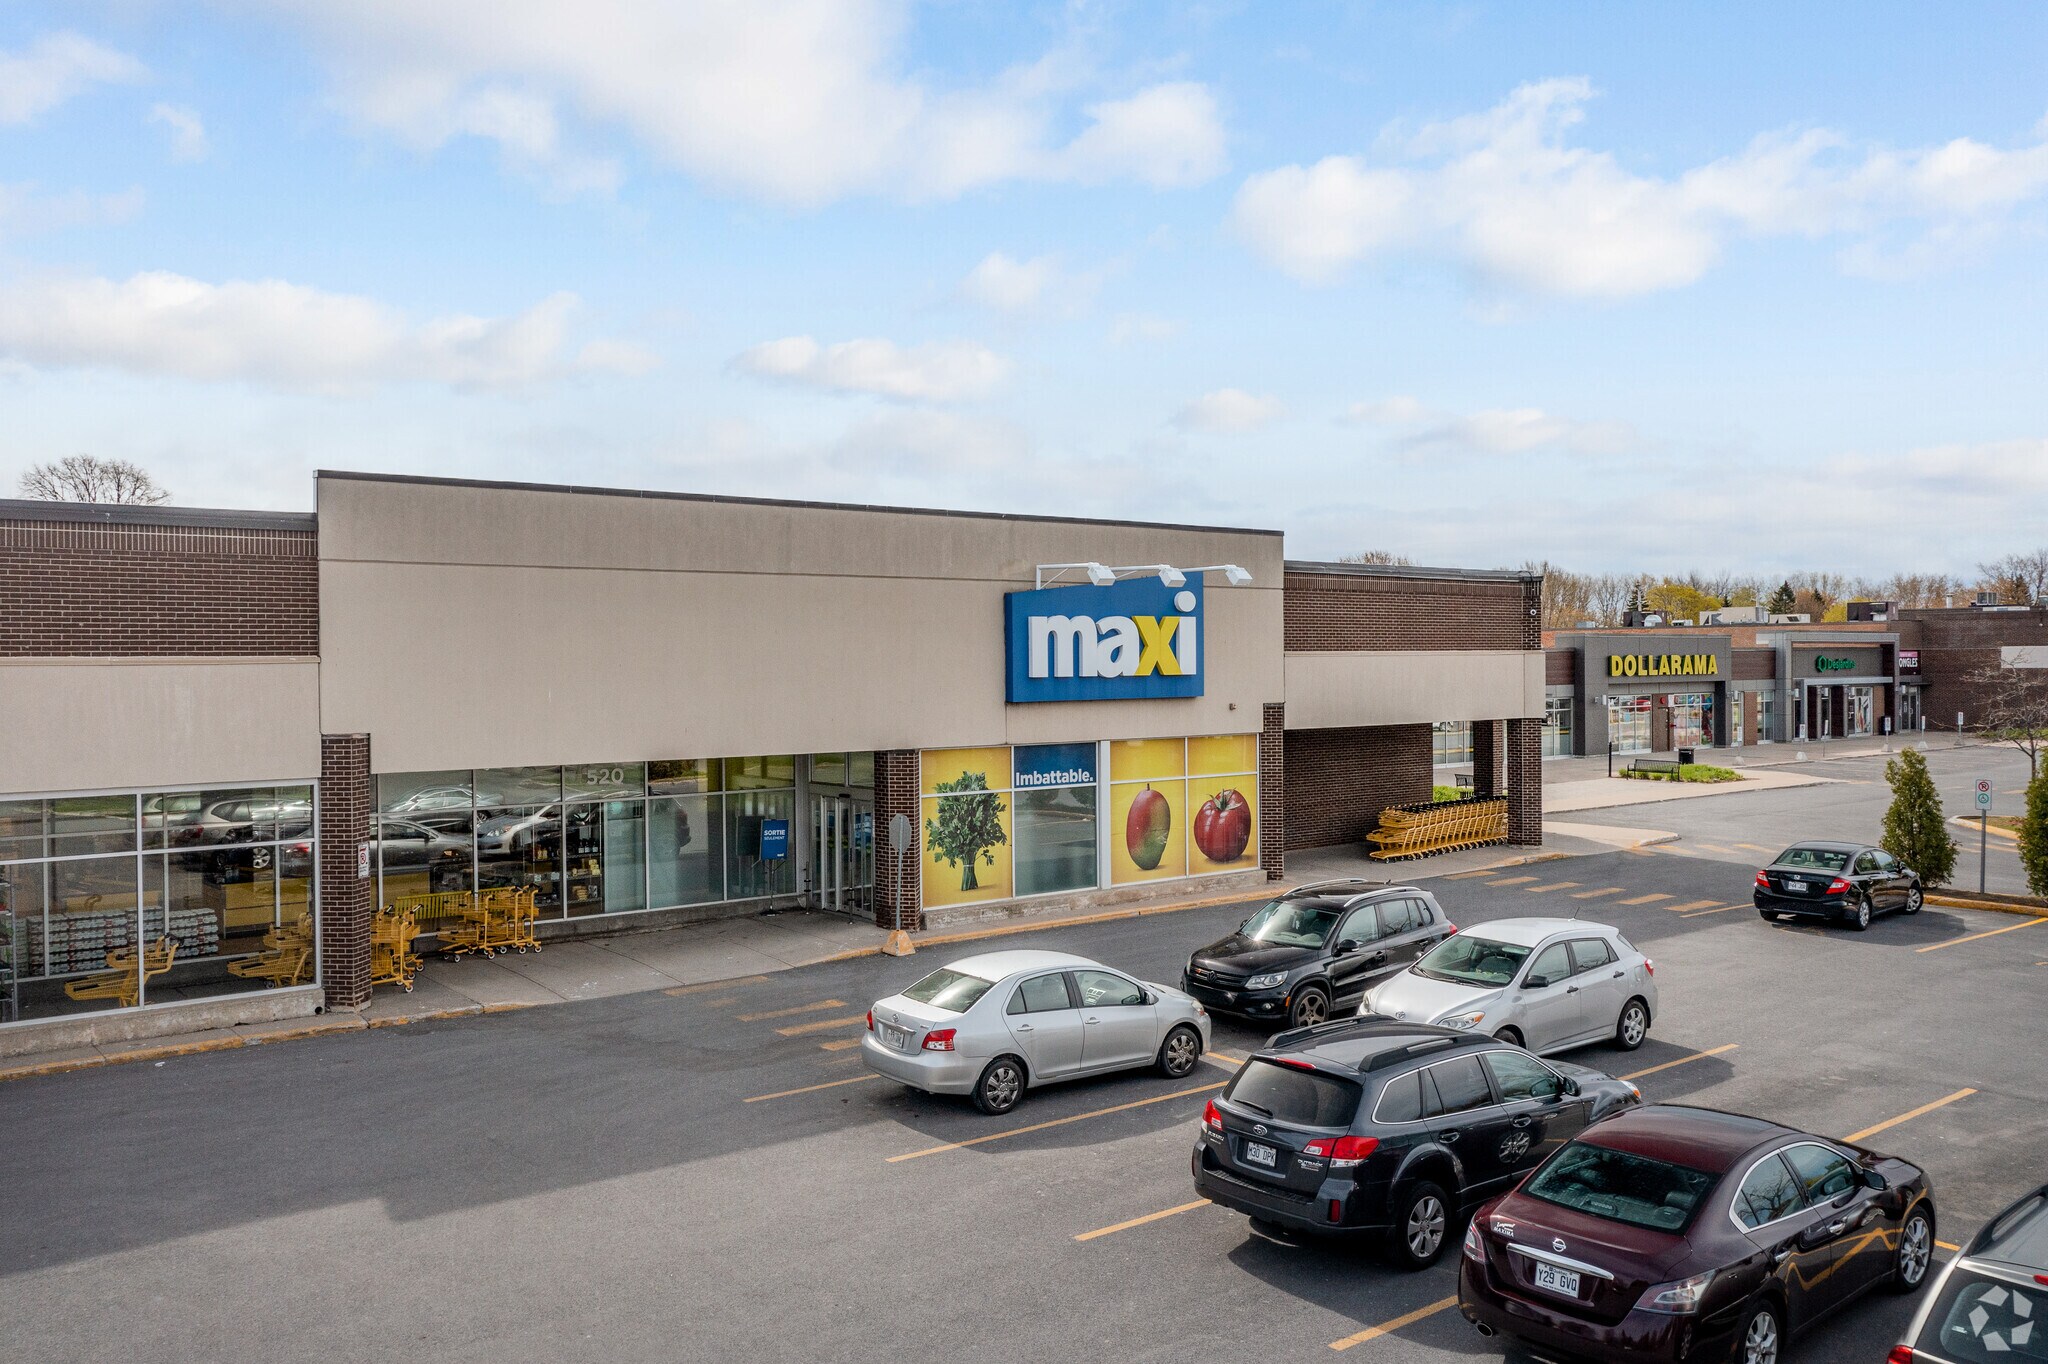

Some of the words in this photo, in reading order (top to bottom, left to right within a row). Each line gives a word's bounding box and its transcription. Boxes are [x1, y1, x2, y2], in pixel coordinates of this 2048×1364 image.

[1028, 591, 1197, 678] maxi
[1609, 654, 1718, 677] DOLLARAMA
[587, 768, 624, 785] 520
[1015, 768, 1094, 786] Imbattable.
[1262, 1150, 1276, 1163] DPK
[1538, 1268, 1555, 1285] Y29
[1559, 1275, 1577, 1292] GVQ
